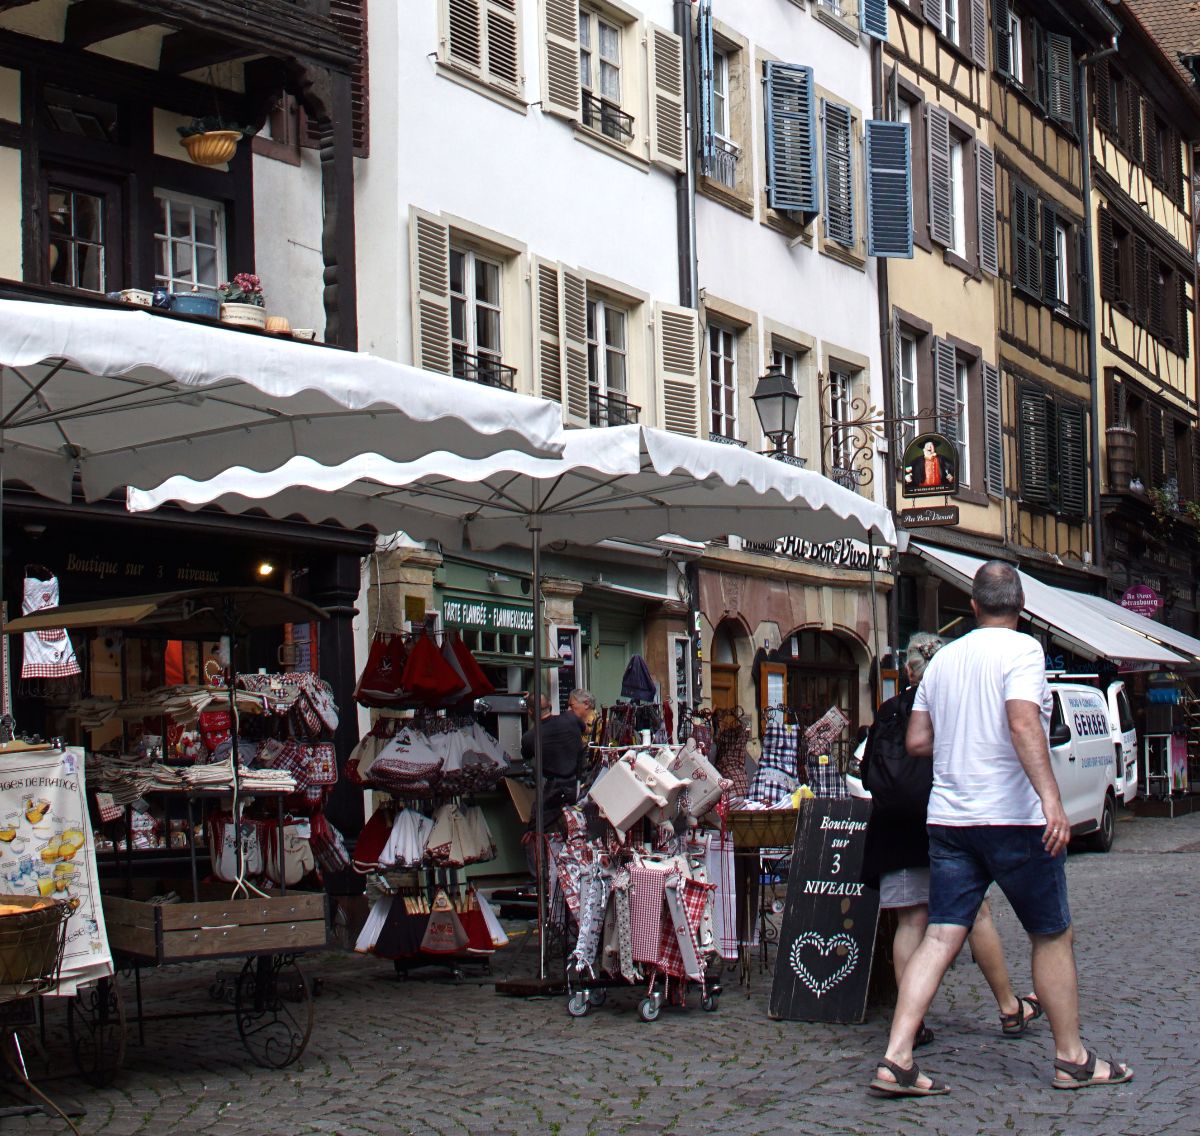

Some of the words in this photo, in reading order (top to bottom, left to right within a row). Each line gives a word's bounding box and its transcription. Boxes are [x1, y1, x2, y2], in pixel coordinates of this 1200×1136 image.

[66, 553, 119, 580] Boutique
[125, 562, 145, 576] sur
[177, 563, 220, 583] niveaux
[1121, 599, 1158, 607] Strasbourg
[443, 602, 461, 623] TARTE
[462, 602, 487, 625] FLAMBÉE
[1073, 712, 1109, 737] GERBER
[39, 776, 78, 792] FRANCE
[820, 815, 868, 835] Boutique
[831, 838, 850, 848] sur
[831, 853, 841, 874] 3
[803, 880, 865, 896] NIVEAUX
